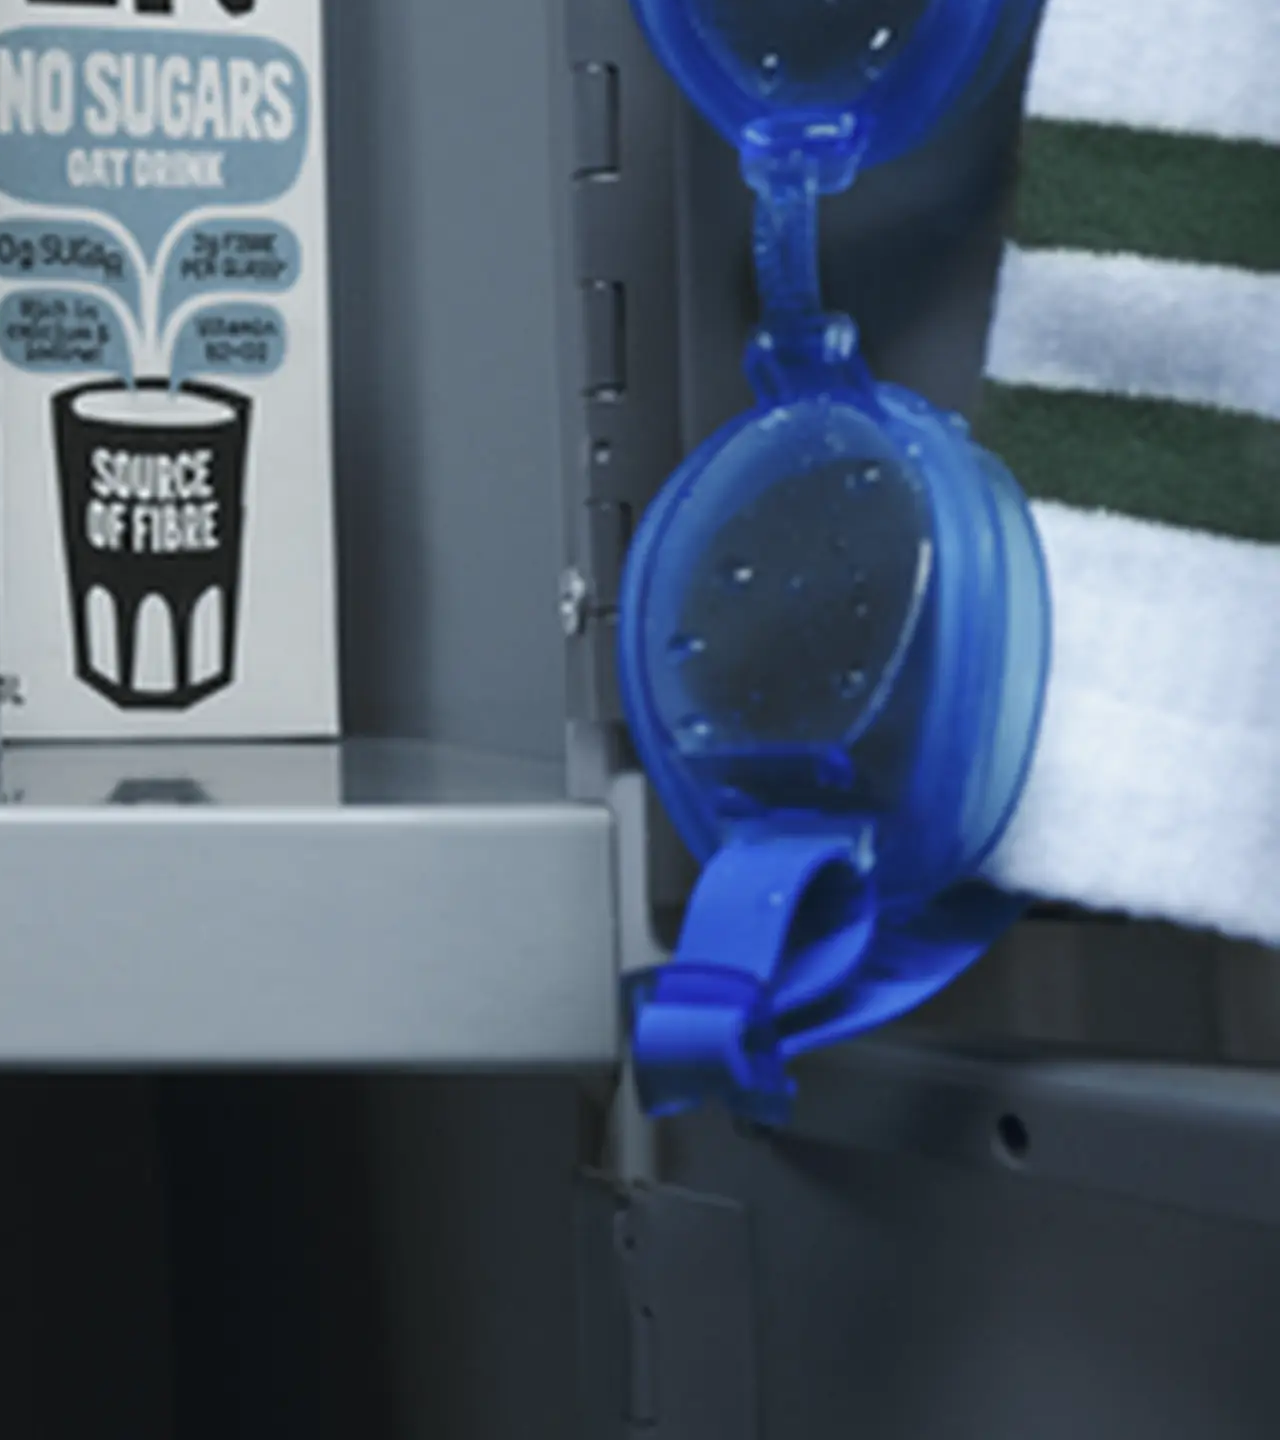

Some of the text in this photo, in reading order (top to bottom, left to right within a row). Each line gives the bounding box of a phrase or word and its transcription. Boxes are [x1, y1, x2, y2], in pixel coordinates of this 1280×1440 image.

[83, 51, 296, 142] SUGARS
[66, 148, 225, 188] OAT DRINK
[91, 448, 213, 500] SOURCE
[86, 501, 220, 552] OF FIBRE
